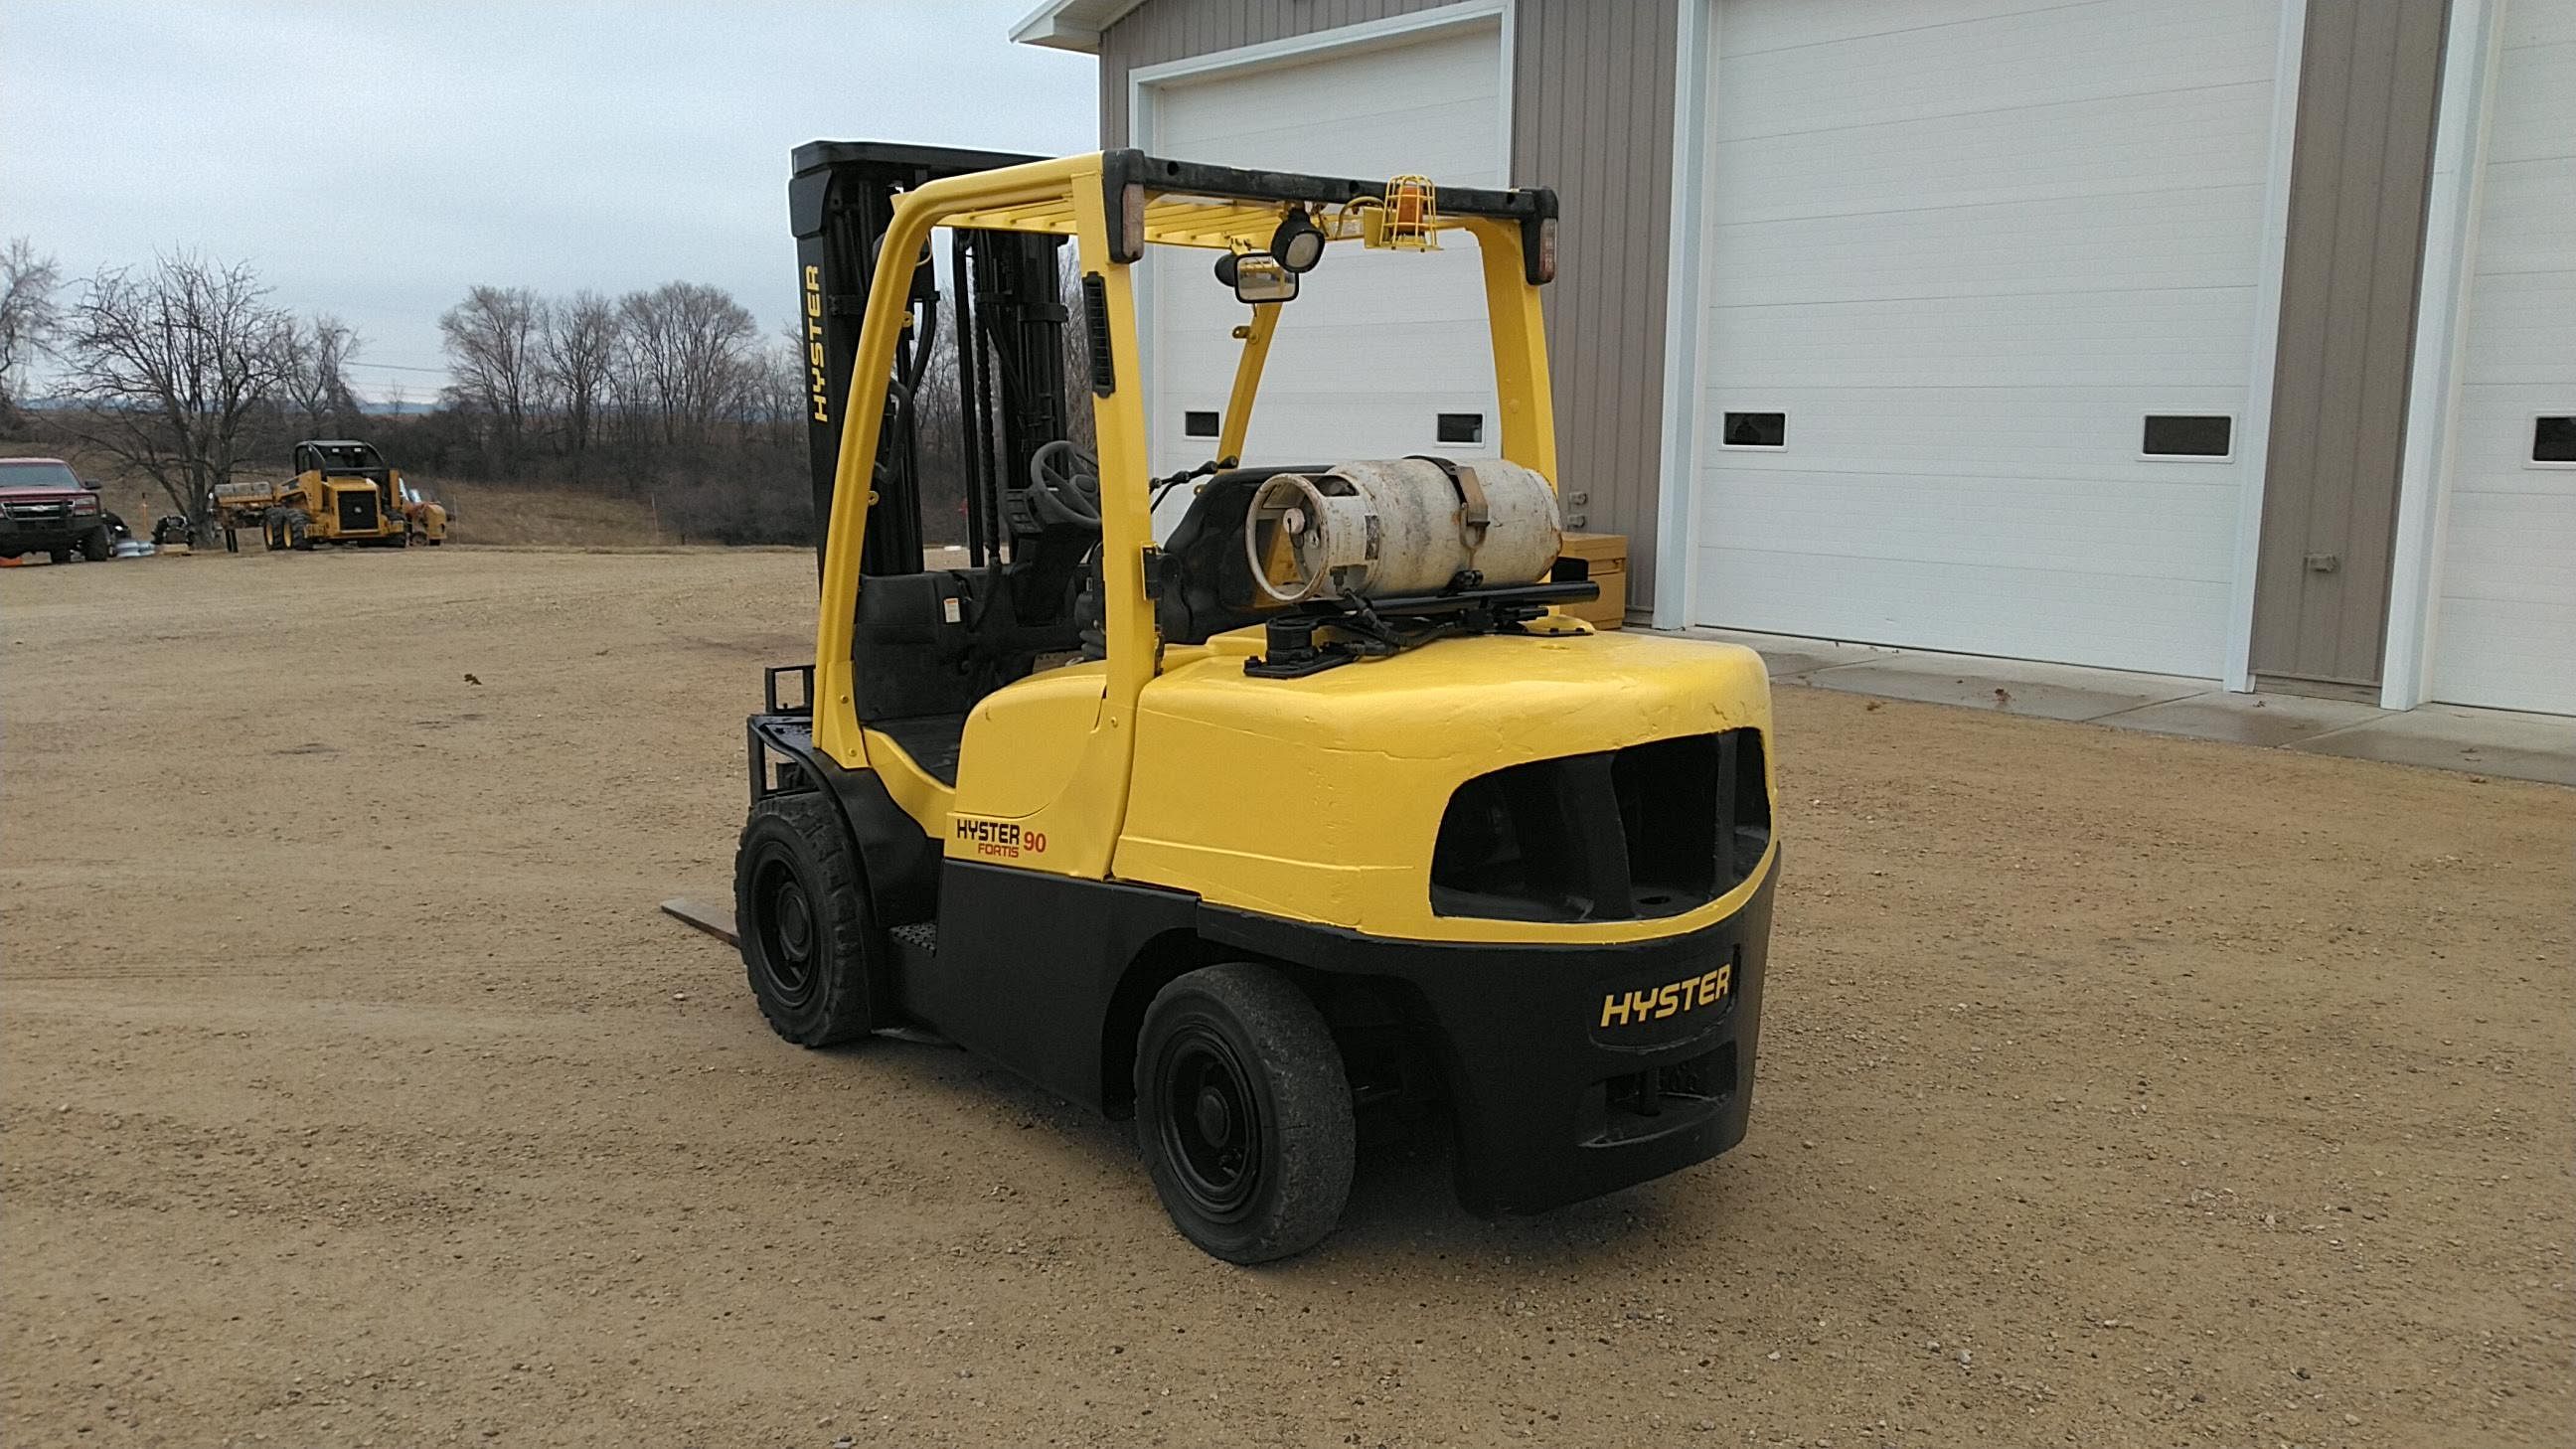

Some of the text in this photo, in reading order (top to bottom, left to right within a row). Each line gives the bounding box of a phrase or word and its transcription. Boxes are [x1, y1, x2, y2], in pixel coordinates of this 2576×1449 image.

[805, 264, 828, 422] HYSTER
[957, 819, 1046, 853] HYSTER 90
[978, 843, 1020, 859] FORTIS
[1600, 964, 1731, 1027] HYSTER
